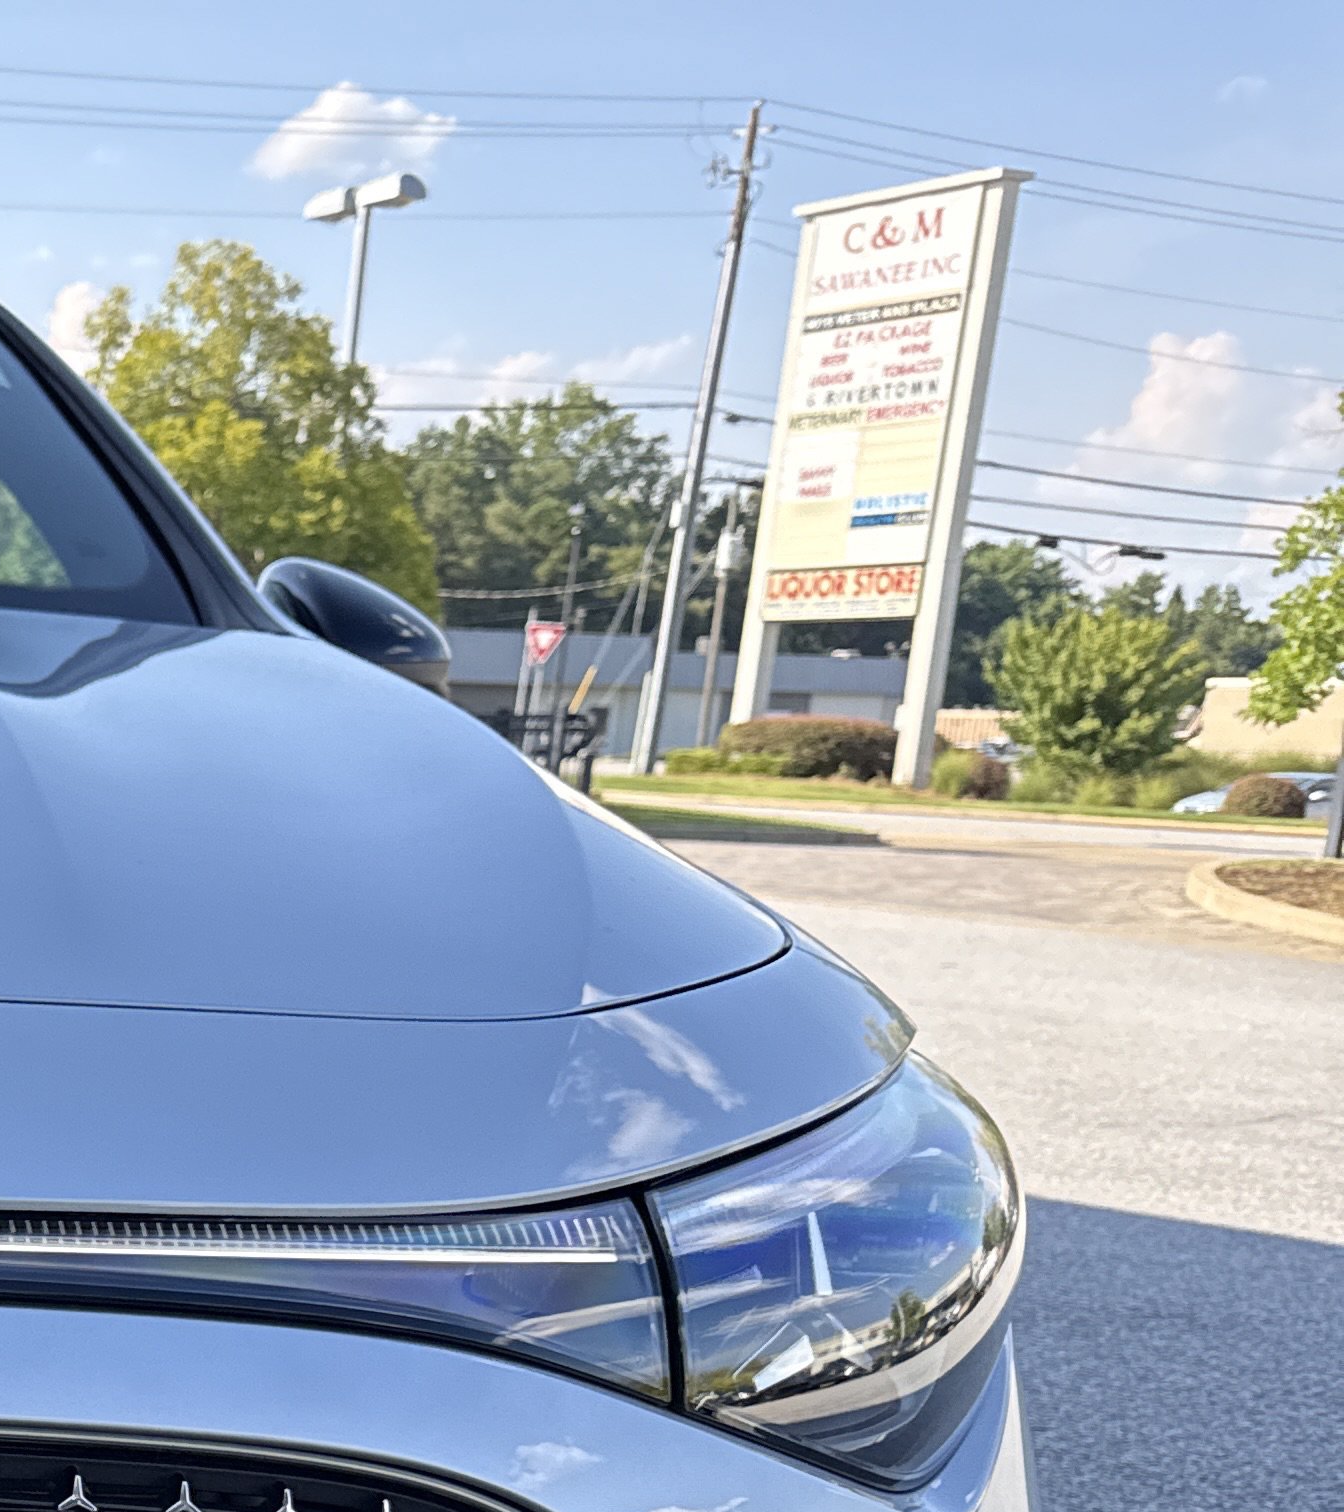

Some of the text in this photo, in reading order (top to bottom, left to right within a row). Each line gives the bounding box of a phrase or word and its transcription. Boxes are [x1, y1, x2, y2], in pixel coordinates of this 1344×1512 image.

[843, 206, 947, 254] C & M
[920, 253, 961, 280] INC
[823, 378, 940, 406] RIVERTOWN
[767, 566, 920, 600] LIQUOR STORE
